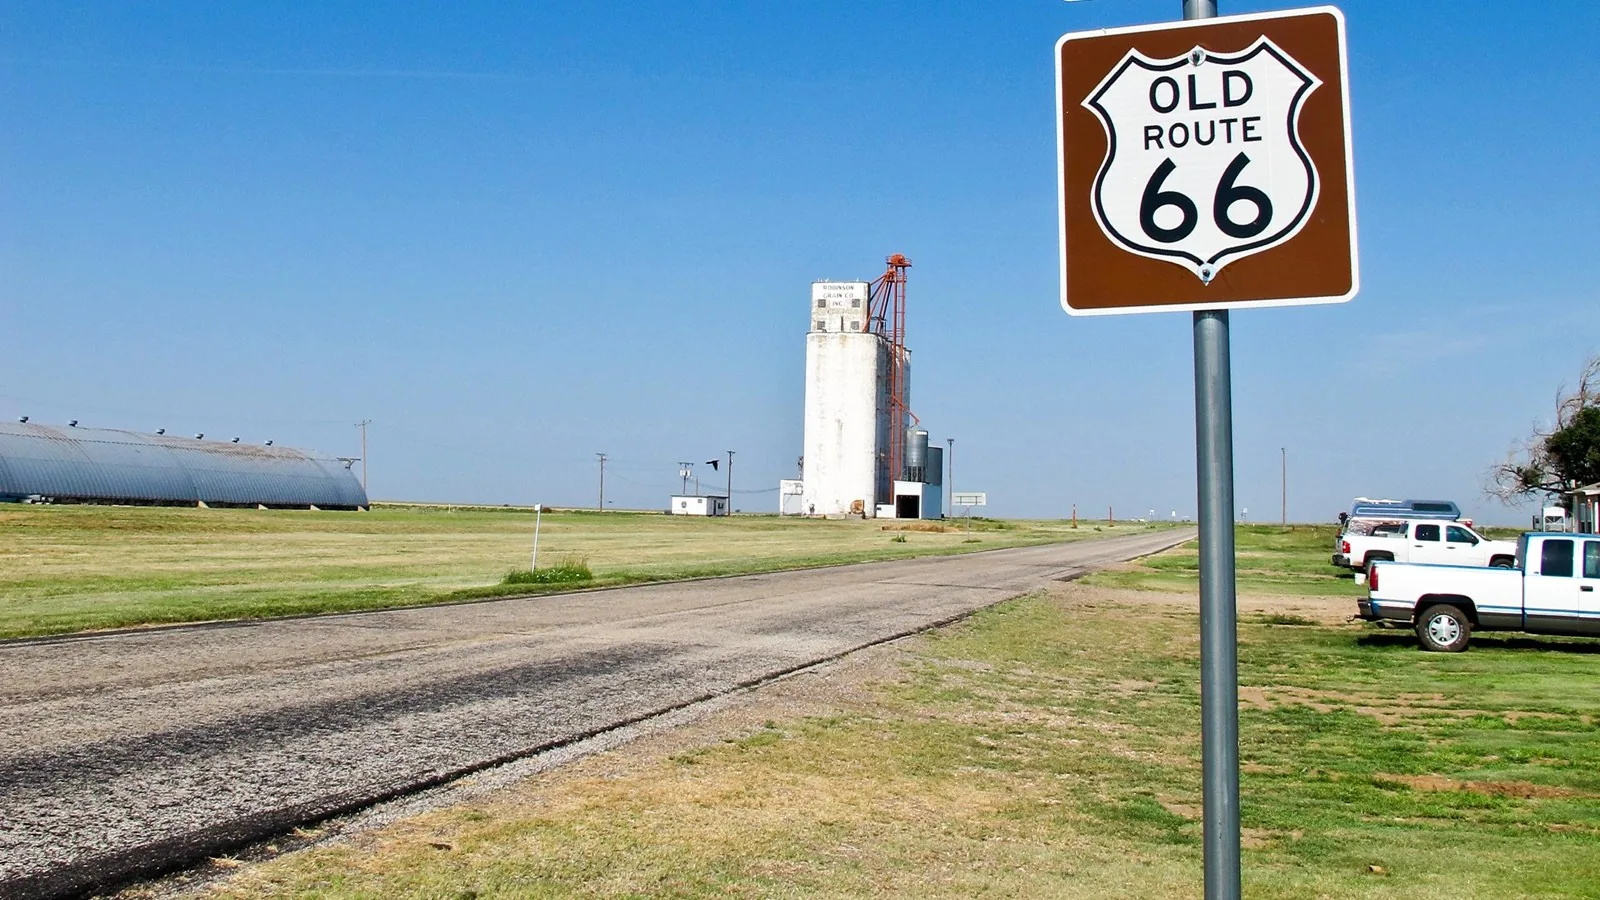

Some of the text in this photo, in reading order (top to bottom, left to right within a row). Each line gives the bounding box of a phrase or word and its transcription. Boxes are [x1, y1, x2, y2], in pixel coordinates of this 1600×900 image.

[1149, 70, 1253, 114] OLD
[1144, 116, 1262, 150] ROUTE
[1140, 151, 1273, 243] 66
